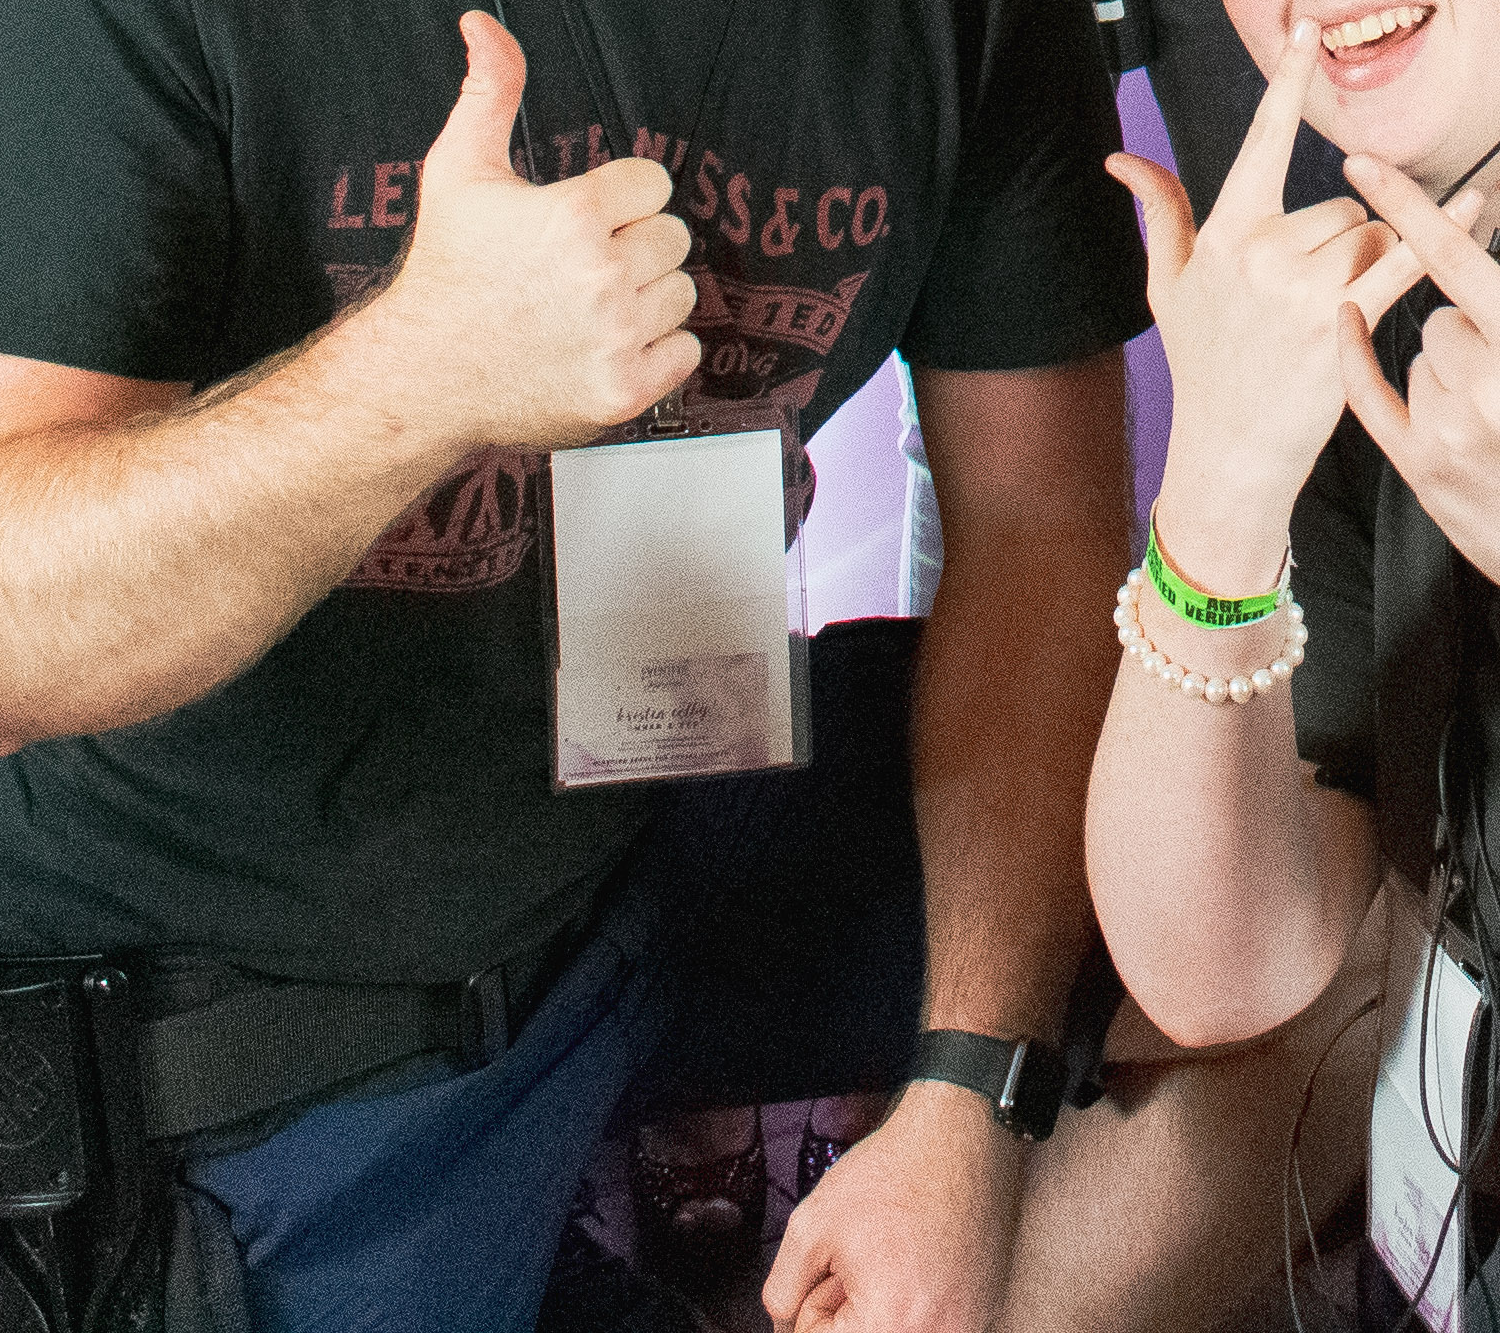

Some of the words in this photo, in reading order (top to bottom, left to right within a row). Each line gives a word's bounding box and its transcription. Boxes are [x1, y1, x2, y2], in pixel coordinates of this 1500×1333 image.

[761, 188, 800, 256] &
[1185, 600, 1265, 627] VERIFIED
[1206, 597, 1244, 614] AGE
